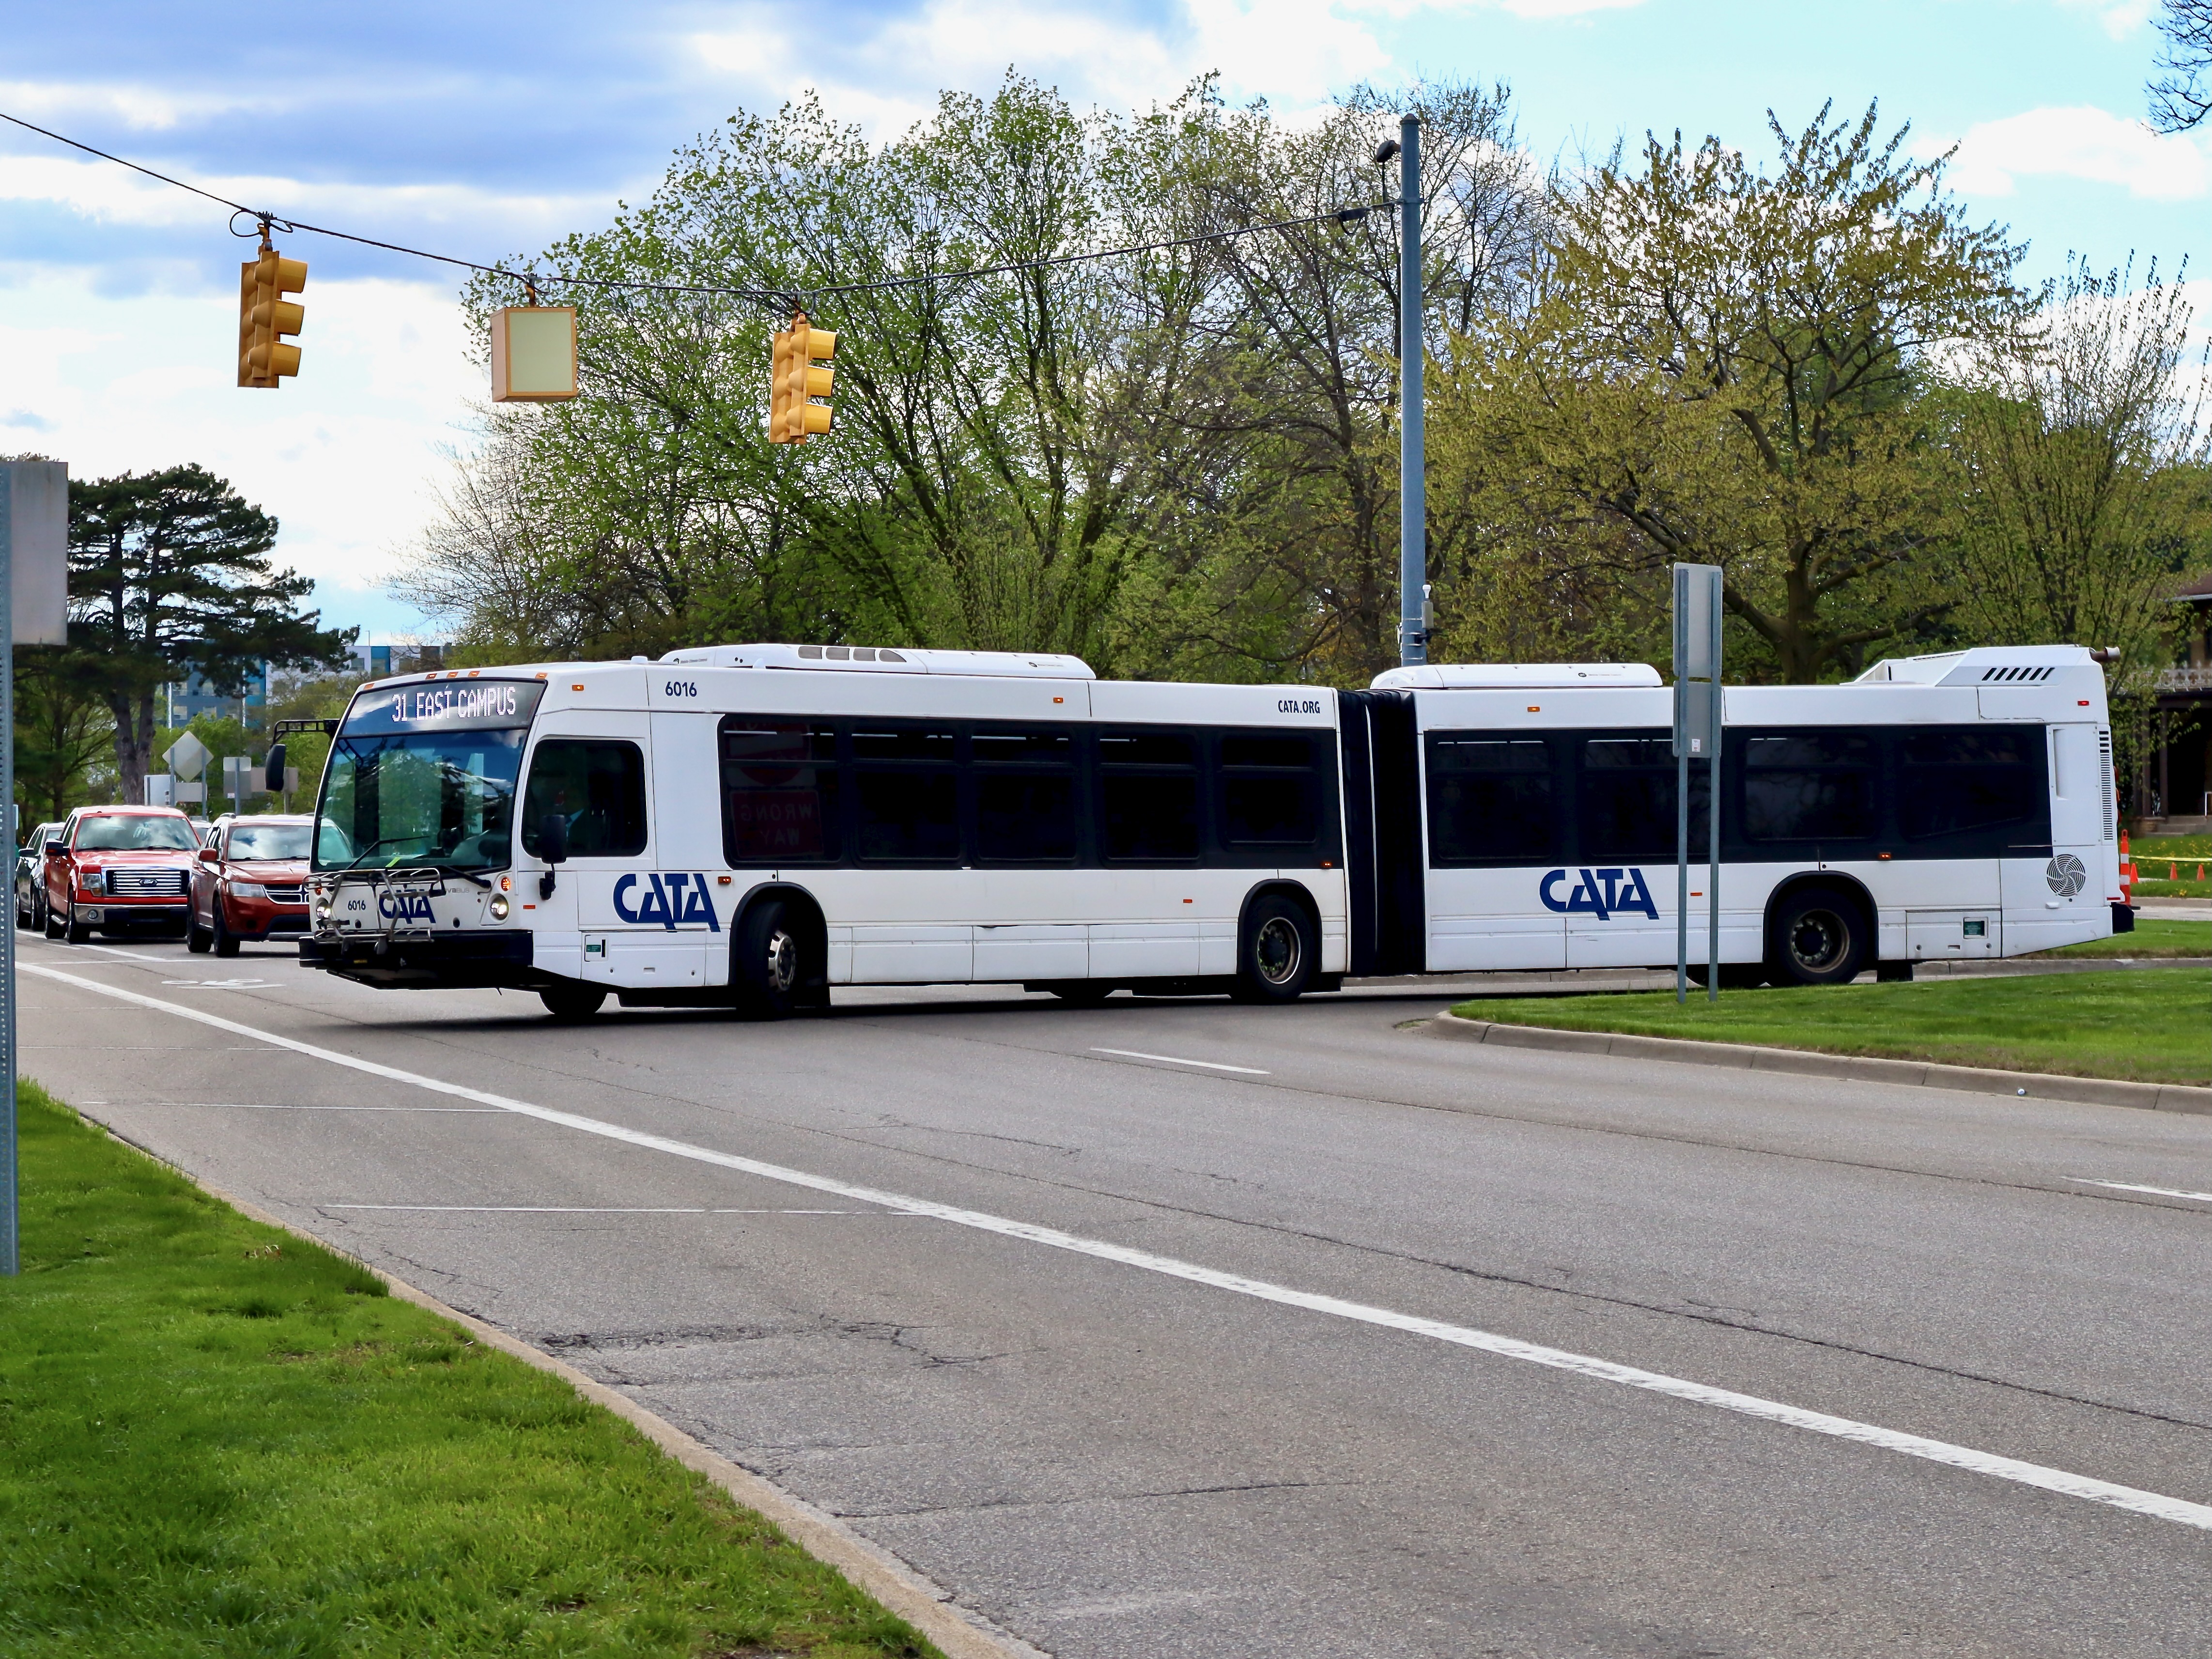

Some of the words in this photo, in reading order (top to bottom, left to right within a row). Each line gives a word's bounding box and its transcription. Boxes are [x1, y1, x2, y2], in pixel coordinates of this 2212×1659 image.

[392, 694, 407, 722] 31
[416, 691, 452, 721] EAST
[458, 686, 516, 718] CAMPUS
[665, 681, 697, 697] 6016
[1278, 700, 1320, 714] CATA.ORG
[347, 900, 366, 911] 6016
[379, 889, 436, 925] CATA
[613, 873, 721, 933] CATA
[1539, 868, 1659, 921] CATA
